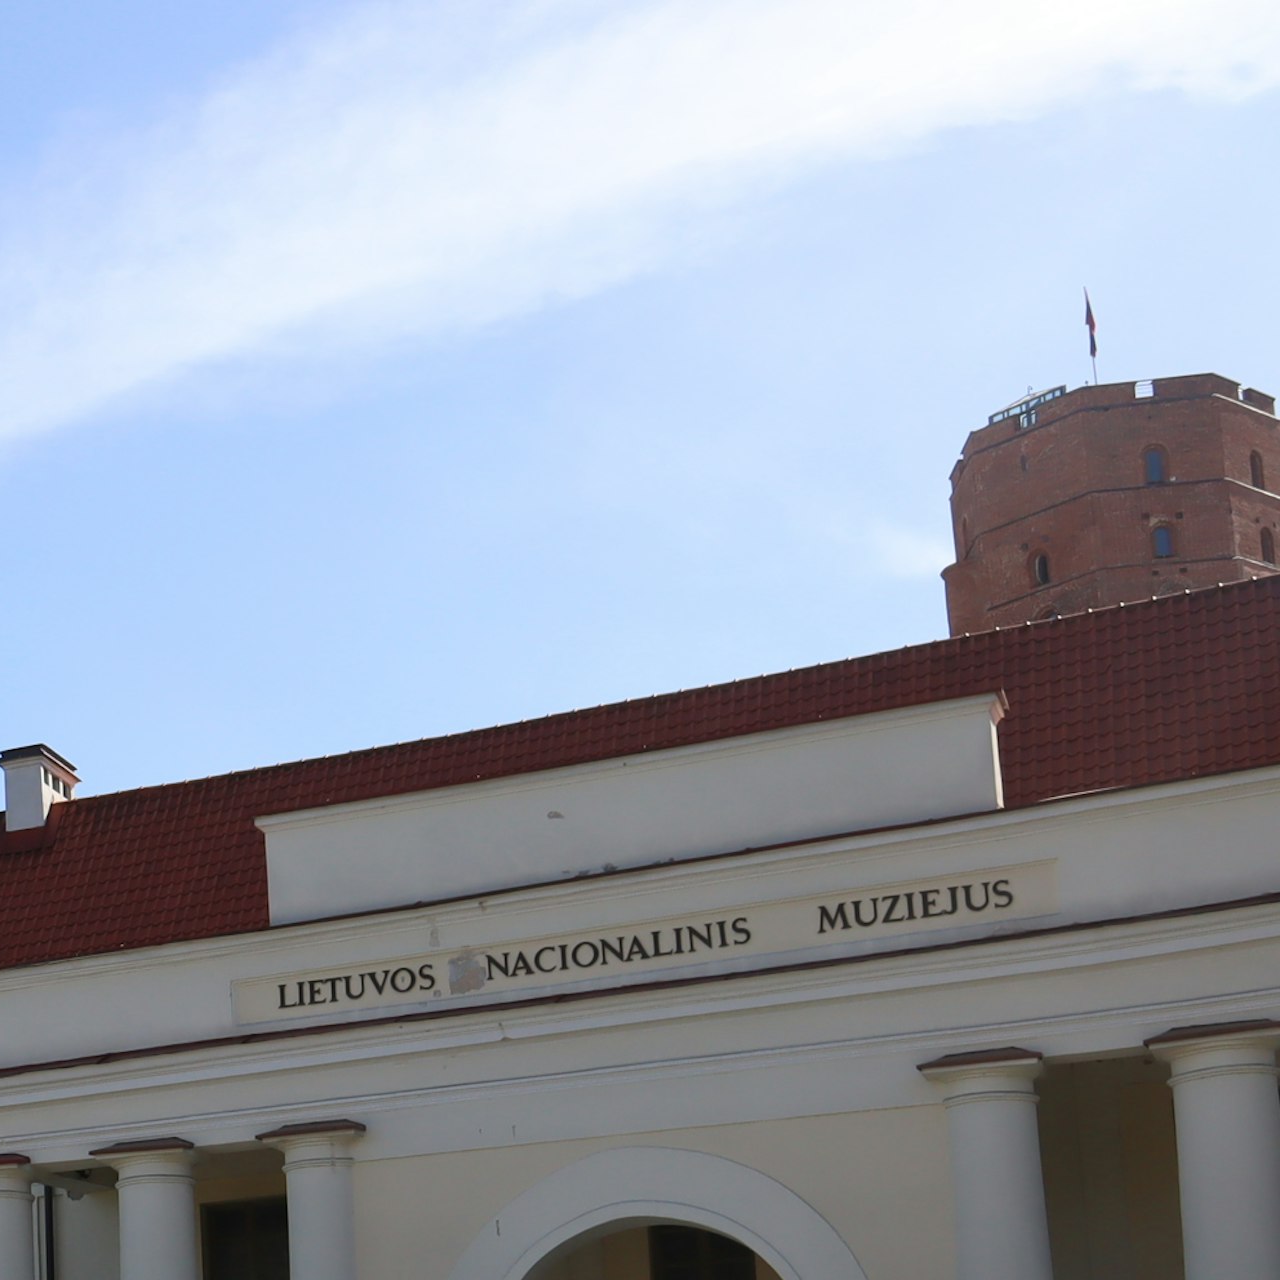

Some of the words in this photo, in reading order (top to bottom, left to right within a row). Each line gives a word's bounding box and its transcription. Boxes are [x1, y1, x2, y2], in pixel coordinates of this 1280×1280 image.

[277, 964, 436, 1010] LIETUVOS
[485, 916, 752, 984] NACIONALINIS
[816, 878, 1015, 935] MUZIEJUS
